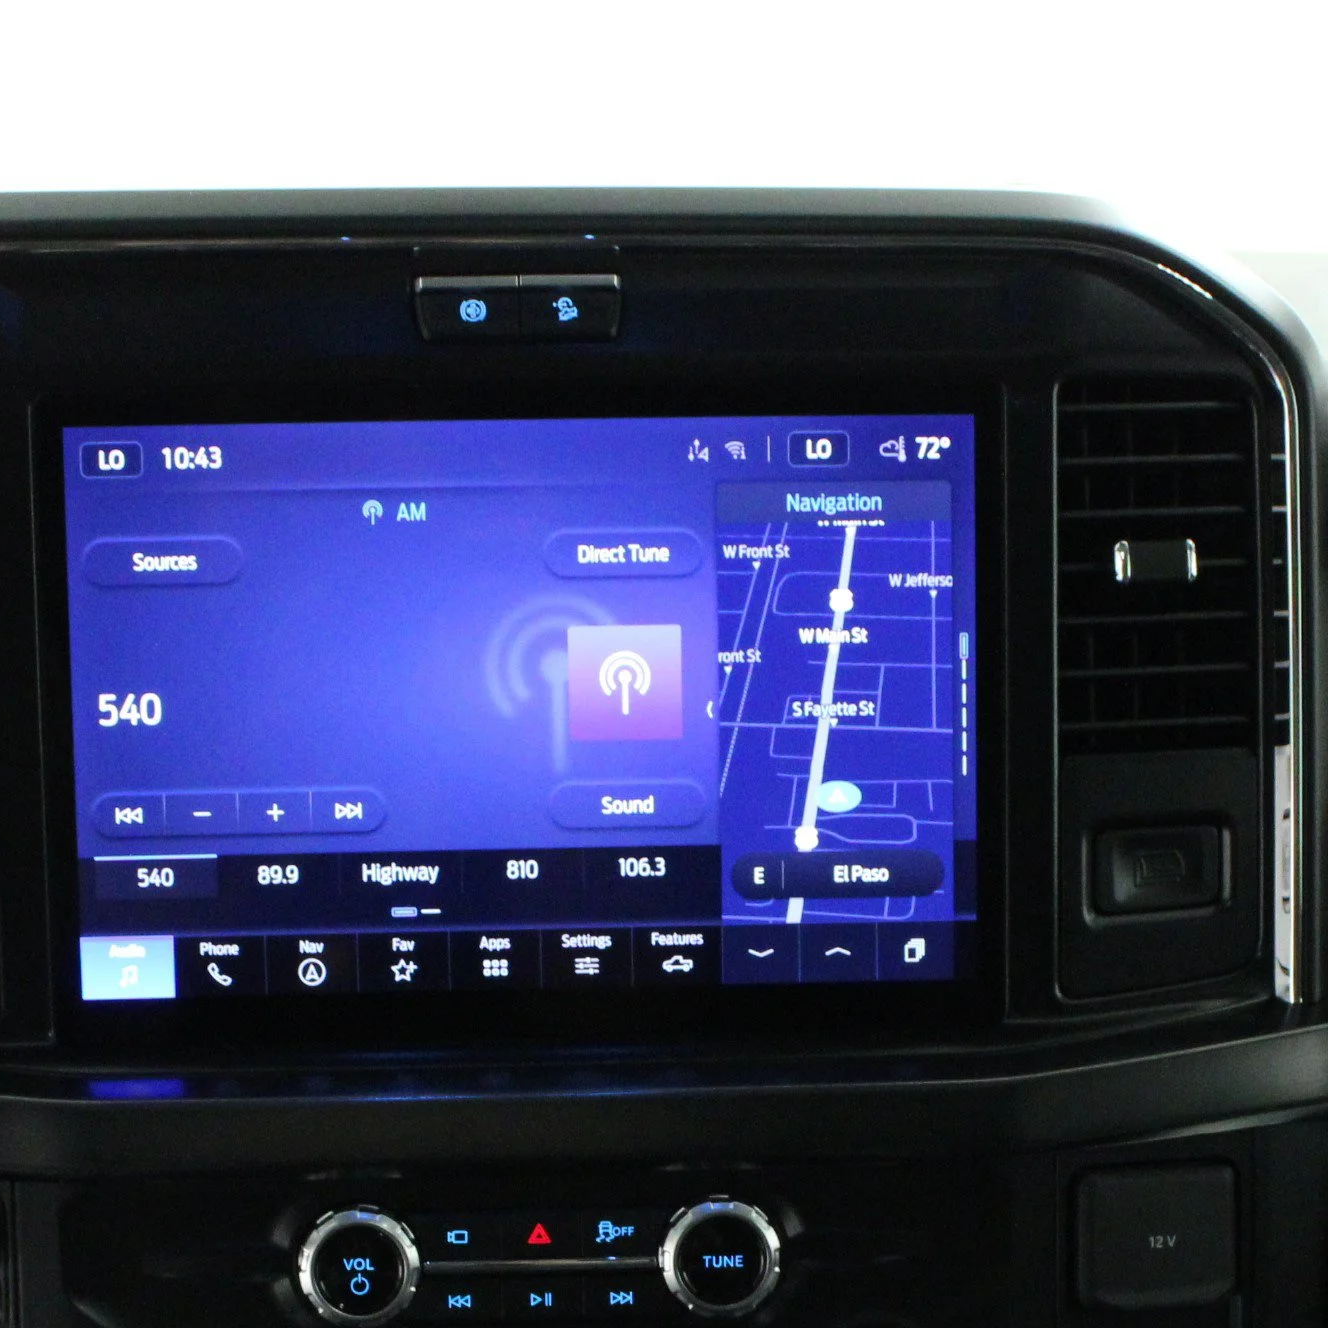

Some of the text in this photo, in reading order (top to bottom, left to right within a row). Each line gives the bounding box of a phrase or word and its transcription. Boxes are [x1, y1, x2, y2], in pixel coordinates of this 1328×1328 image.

[805, 438, 832, 460] LO
[915, 436, 951, 459] 72°
[97, 448, 125, 471] LO
[161, 445, 222, 470] 10:43
[396, 502, 427, 522] AM
[786, 493, 883, 515] Navigation
[577, 543, 670, 564] Direct Tune
[739, 544, 773, 559] Front
[775, 543, 790, 559] St
[132, 552, 198, 573] Sources
[799, 628, 815, 644] W
[851, 626, 868, 643] St
[746, 648, 762, 663] St
[98, 692, 162, 727] 540
[792, 700, 875, 719] S Fayette St
[601, 795, 655, 815] Sound
[257, 864, 299, 885] 89.9
[362, 863, 440, 886] Highway
[506, 859, 539, 880] 810
[618, 857, 666, 878] 106.3
[753, 866, 765, 885] E
[833, 865, 890, 883] El Paso
[137, 867, 174, 888] 540
[299, 940, 325, 954] Nav
[391, 937, 415, 952] Fav
[479, 935, 511, 952] Apps
[561, 933, 612, 950] Settings
[651, 931, 704, 947] Features
[199, 941, 240, 957] Phone
[612, 1225, 635, 1237] OFF
[343, 1258, 374, 1271] VOL
[703, 1255, 744, 1268] TUNE
